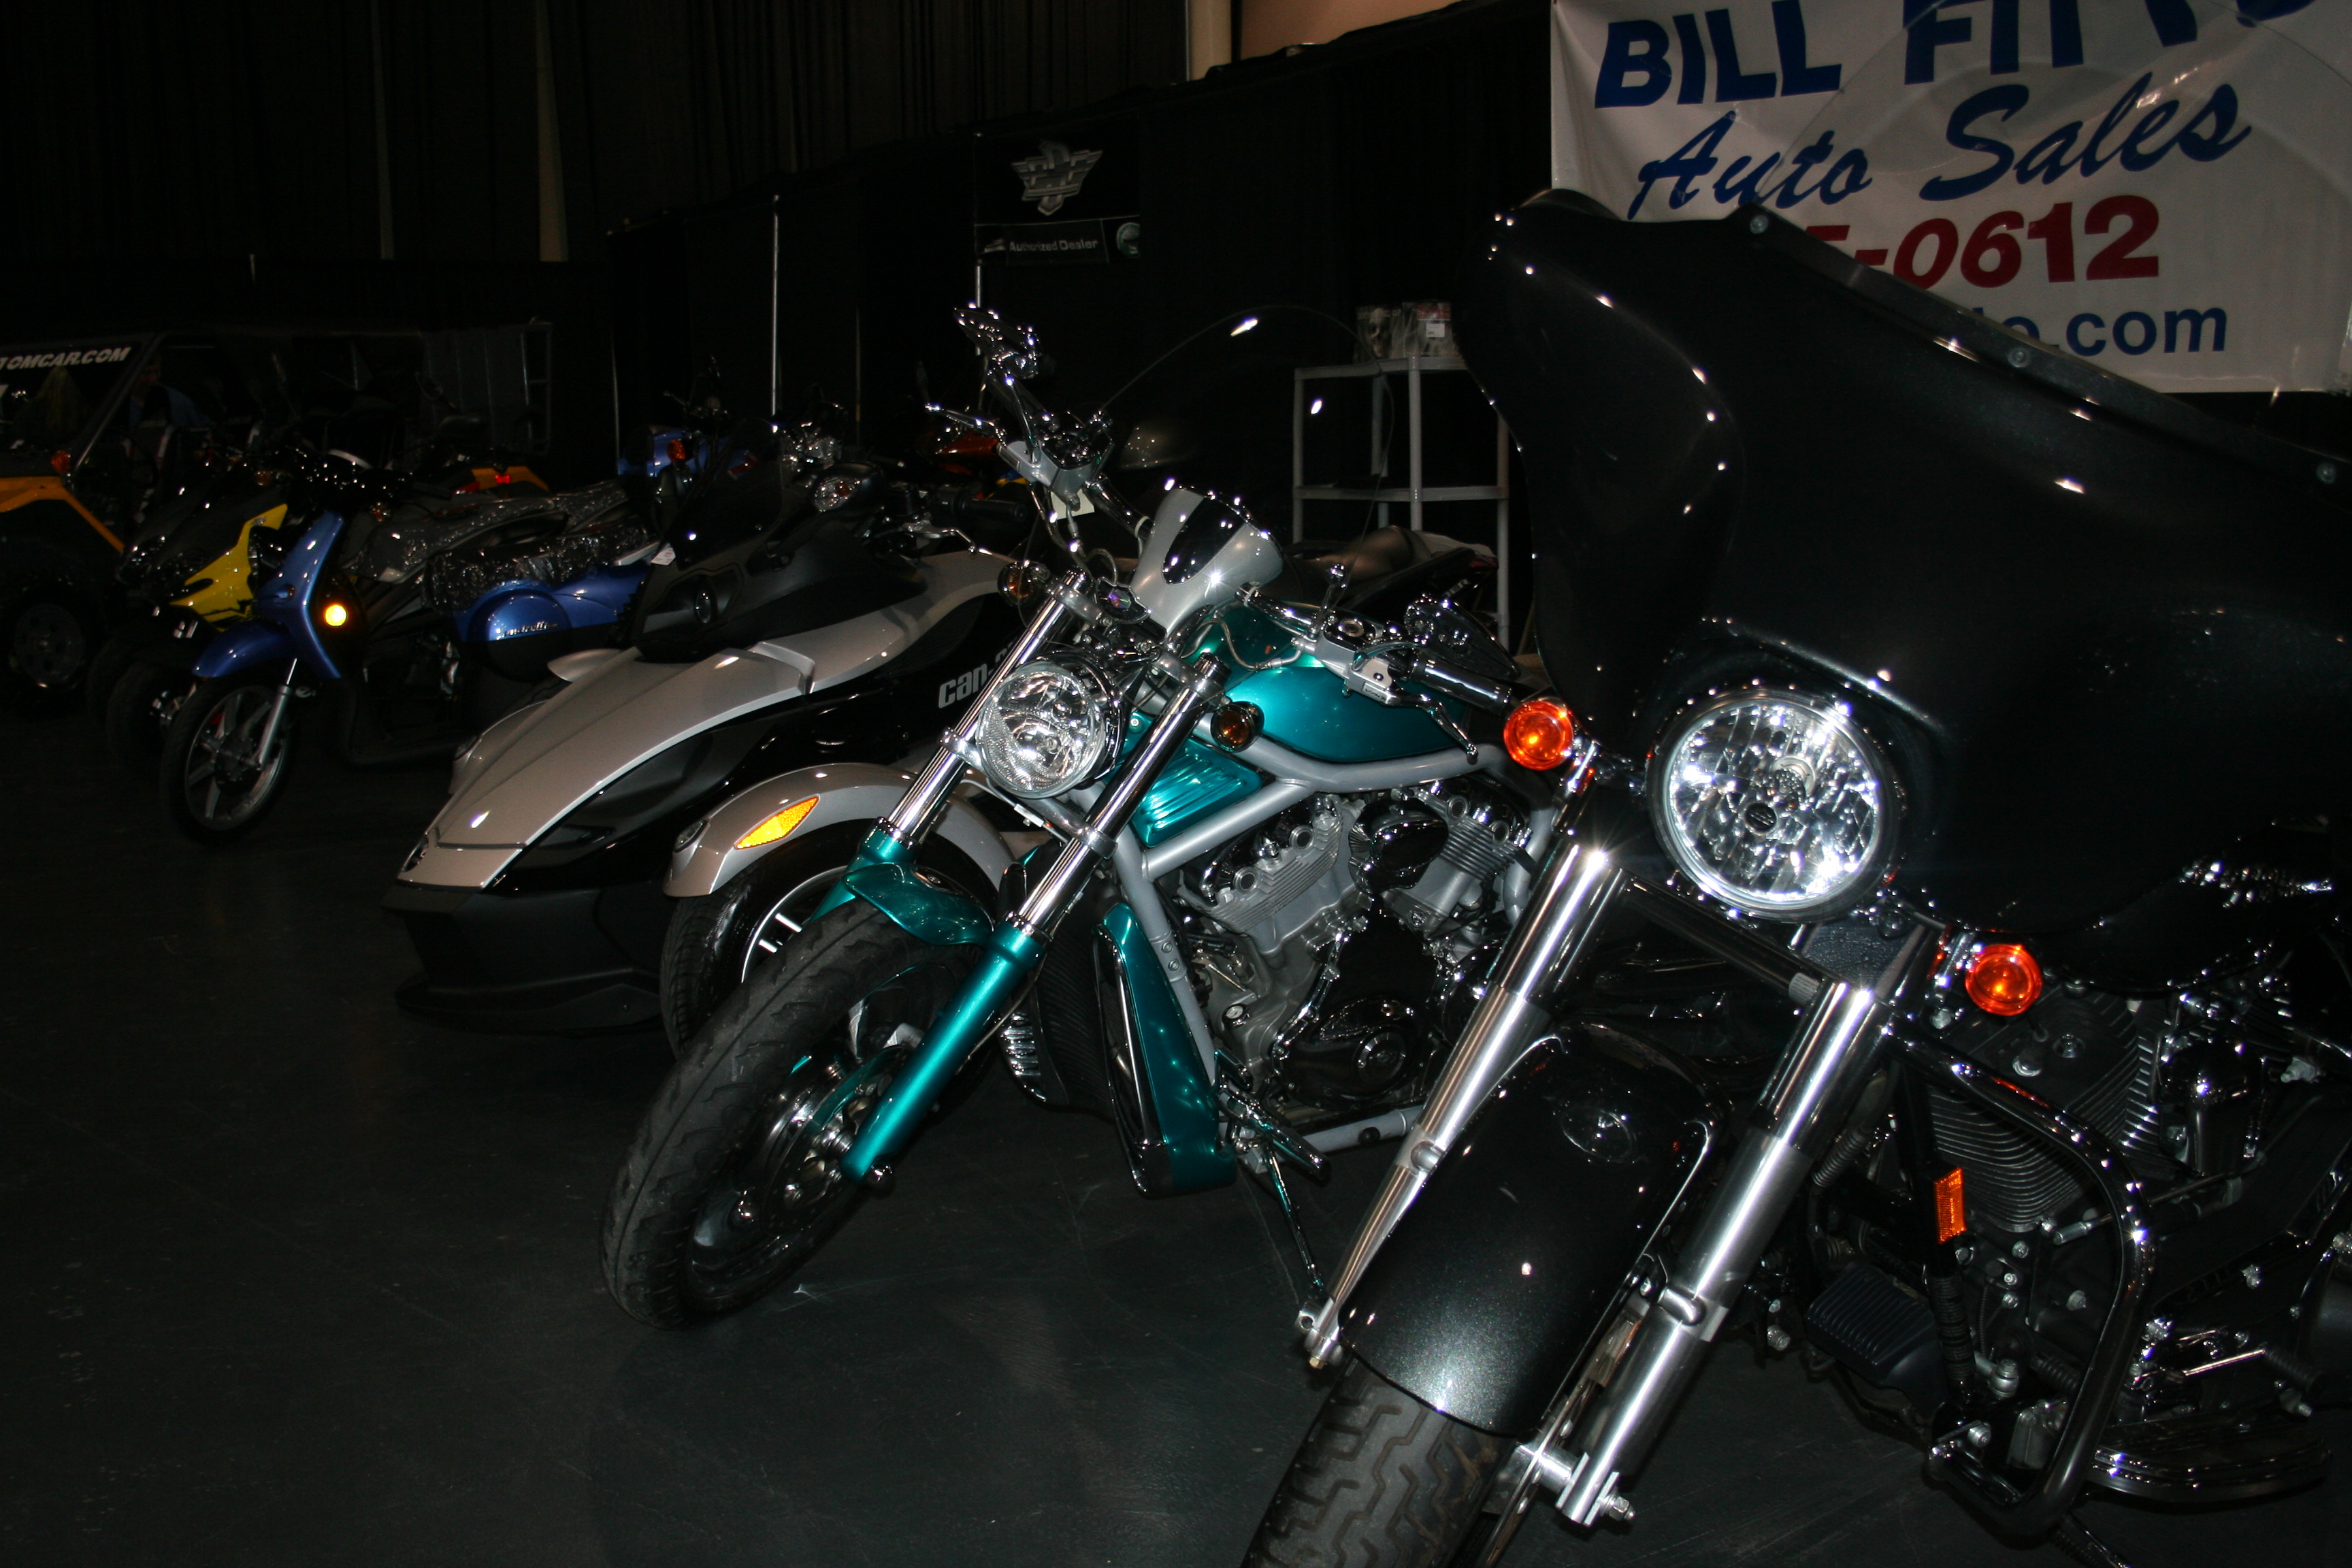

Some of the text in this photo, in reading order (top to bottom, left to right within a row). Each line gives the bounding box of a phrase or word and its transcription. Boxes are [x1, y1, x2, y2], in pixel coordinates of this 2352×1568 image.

[1595, 0, 1842, 109] BILL
[1627, 72, 2251, 220] Auto Sales
[1009, 241, 1057, 252] Authorized
[1059, 239, 1098, 250] Dealer
